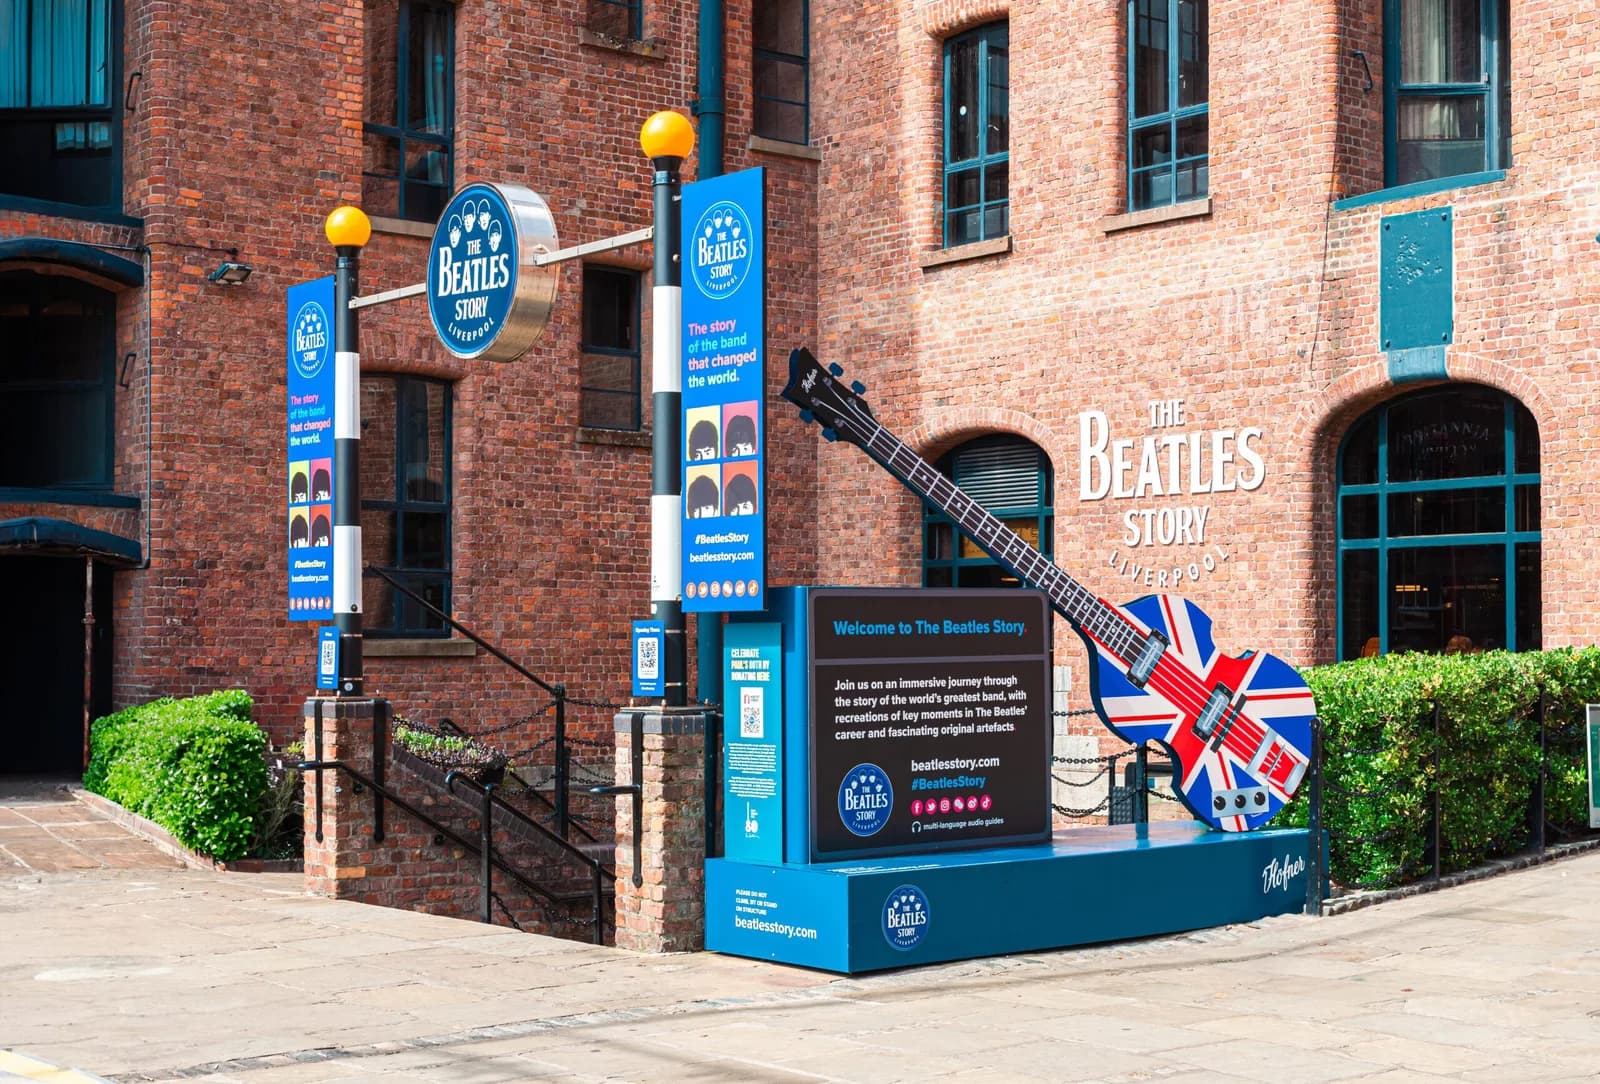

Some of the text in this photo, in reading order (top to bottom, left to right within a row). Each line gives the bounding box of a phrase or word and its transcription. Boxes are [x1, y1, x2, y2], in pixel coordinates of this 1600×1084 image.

[717, 232, 727, 242] THE
[467, 239, 481, 256] THE
[698, 237, 747, 267] BEATLES
[438, 246, 510, 297] BEATLES
[710, 263, 733, 279] STORY
[455, 296, 488, 321] STORY
[448, 317, 494, 342] LIVERPOOL
[688, 319, 736, 336] The story
[296, 329, 325, 352] BEATLES
[688, 332, 747, 354] of the band
[688, 348, 757, 371] that changed
[688, 368, 740, 388] the world.
[303, 394, 319, 405] story
[309, 404, 326, 416] band
[1149, 398, 1186, 429] THE
[303, 417, 331, 431] changed
[1079, 410, 1266, 502] BEATLES
[1123, 506, 1209, 547] STORY
[695, 533, 749, 545] #BeatlesStory
[689, 551, 754, 564] beatlesstory.com
[1108, 544, 1230, 588] LIVERPOOL
[832, 618, 1027, 636] Welcome to The Beatles Story.
[834, 675, 1018, 691] Join us on an immersive journey through
[835, 690, 1027, 709] the story of the world's greatest band, with
[835, 705, 1028, 724] recreations of key moments in The Beatles'
[835, 729, 866, 740] career
[868, 727, 886, 739] and
[888, 725, 939, 738] fascinating
[941, 723, 975, 735] original
[911, 757, 1000, 772] beatlesstory.com
[911, 776, 986, 791] #BeatlesStory
[845, 788, 888, 810] BEATLES
[856, 810, 876, 821] STORY
[923, 817, 1004, 831] multi-language audio guides
[888, 907, 927, 928] BEATLES
[735, 915, 817, 939] beatlesstory.com
[897, 928, 915, 937] STORY
